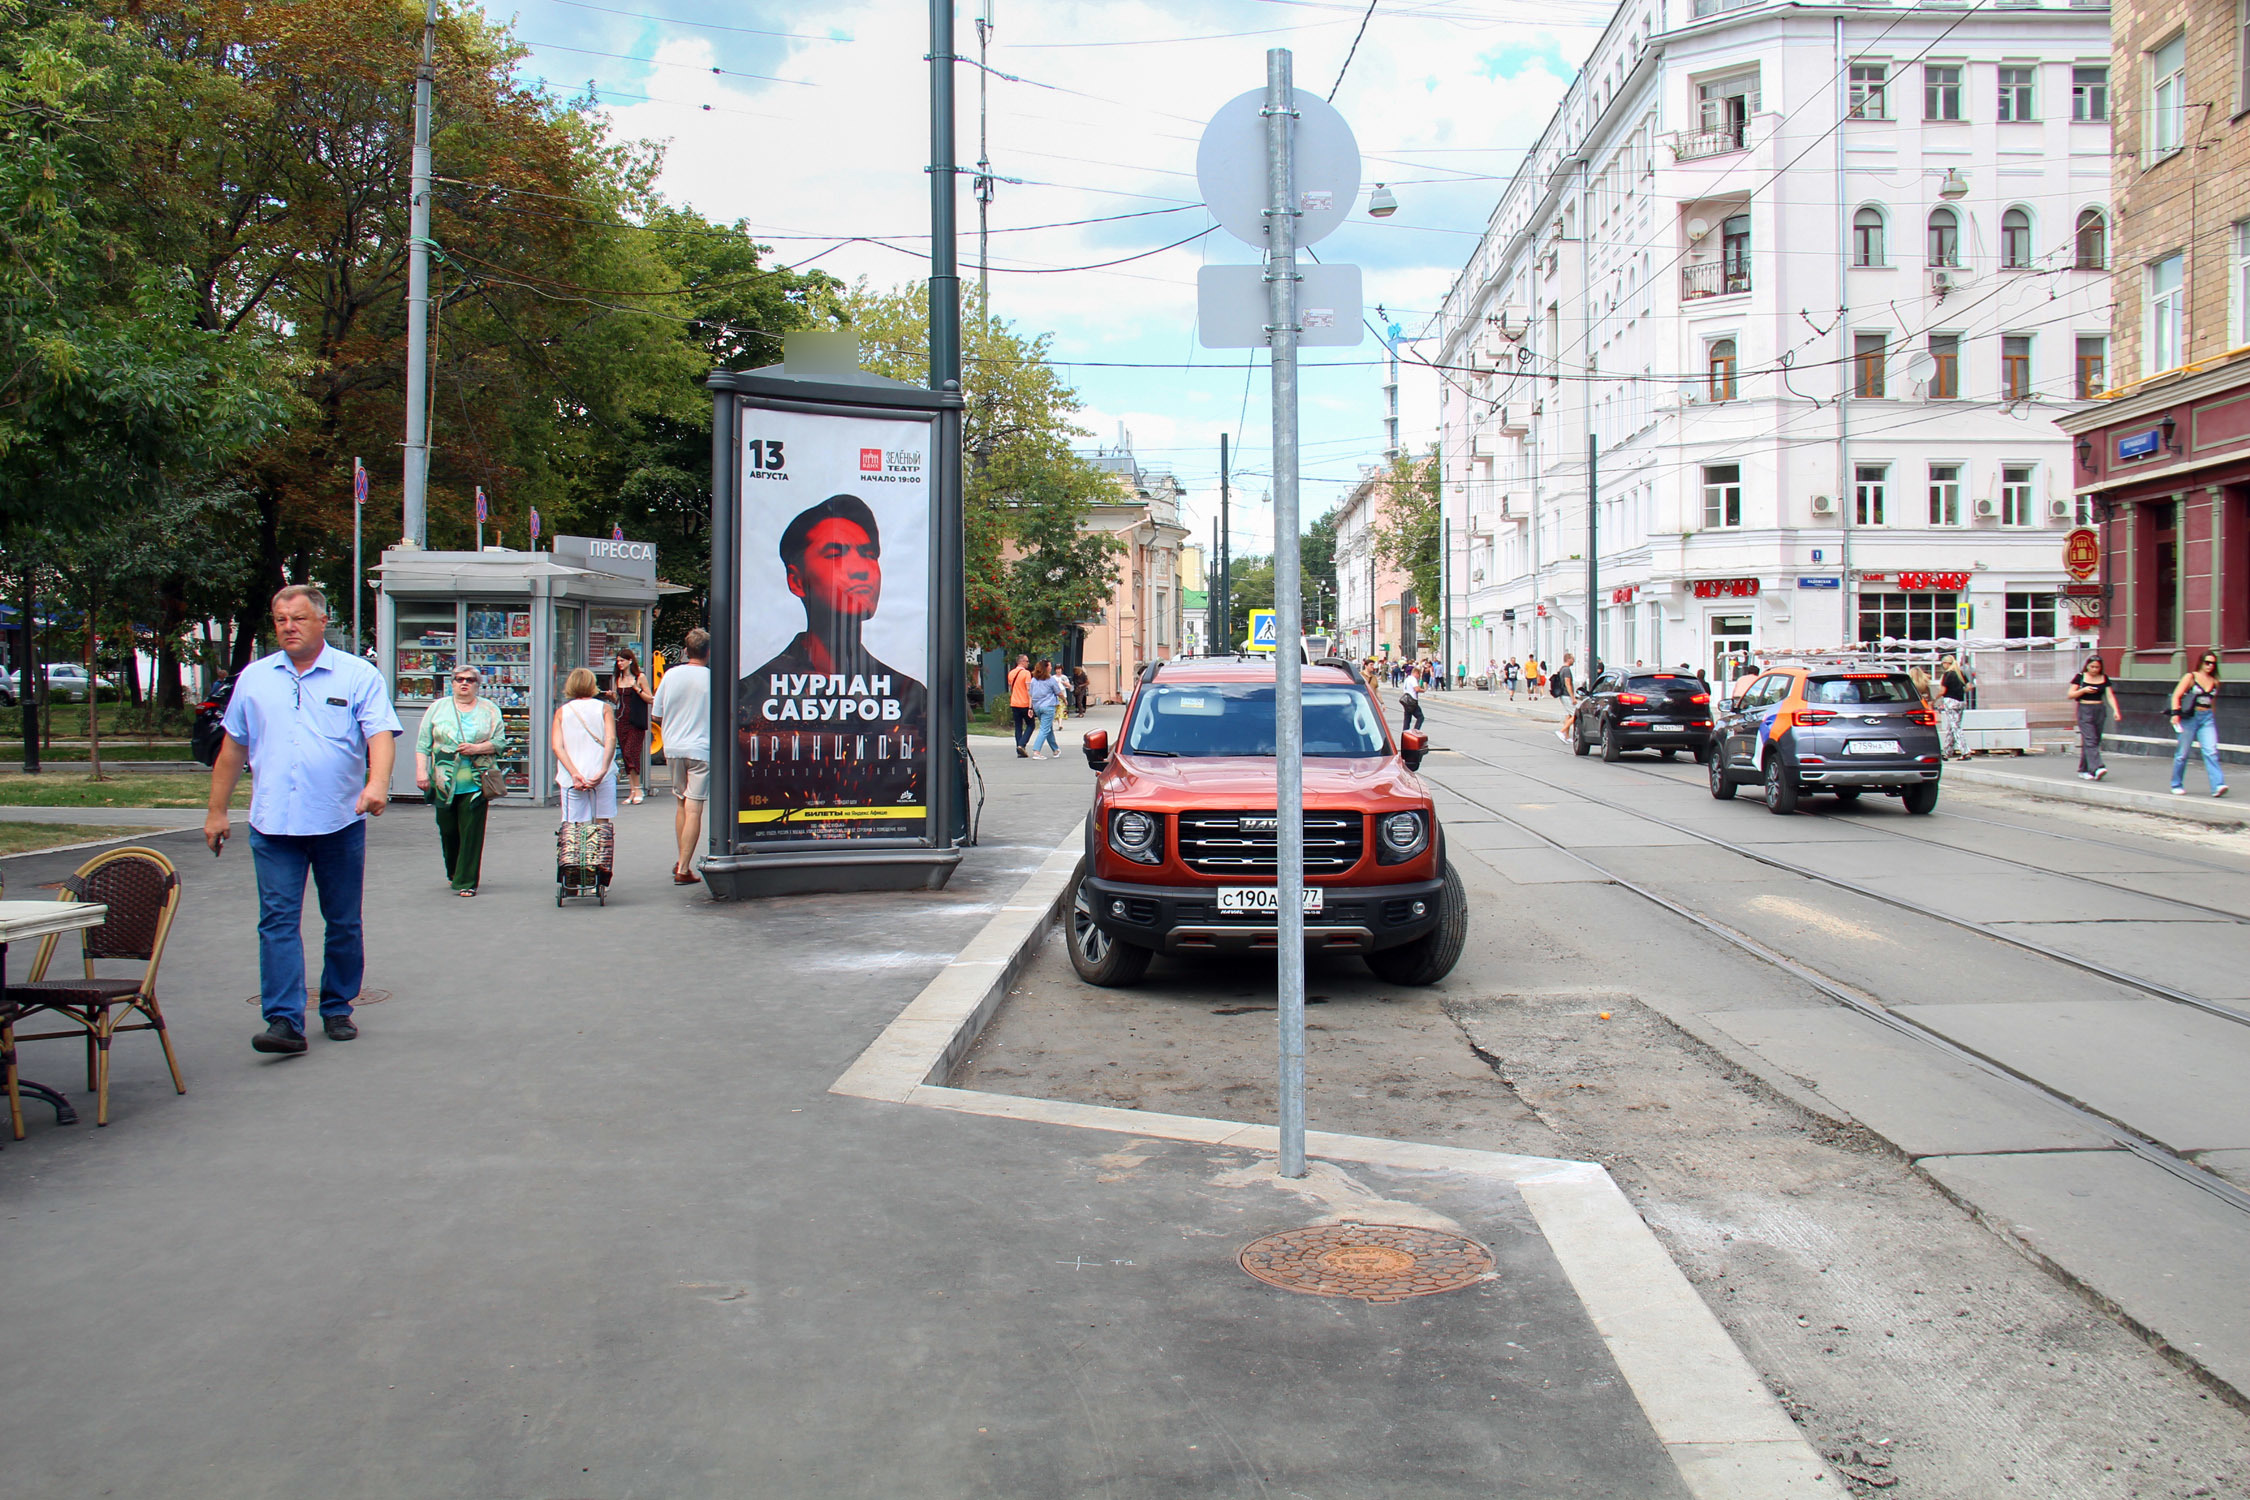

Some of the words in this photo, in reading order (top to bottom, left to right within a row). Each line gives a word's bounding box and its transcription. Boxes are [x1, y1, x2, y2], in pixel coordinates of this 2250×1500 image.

[749, 439, 785, 471] 13
[885, 449, 921, 465] ЗЕЛЁНЫЙ
[749, 471, 789, 481] АВГУСТА
[860, 474, 896, 482] НАЧАЛО
[590, 541, 652, 560] ПРЕССА
[770, 673, 891, 696] НУРЛАН
[761, 698, 902, 721] САБУРОВ
[750, 734, 913, 762] ПРИНЦИПЫ
[749, 795, 769, 806] 18+
[1244, 820, 1277, 829] HAV
